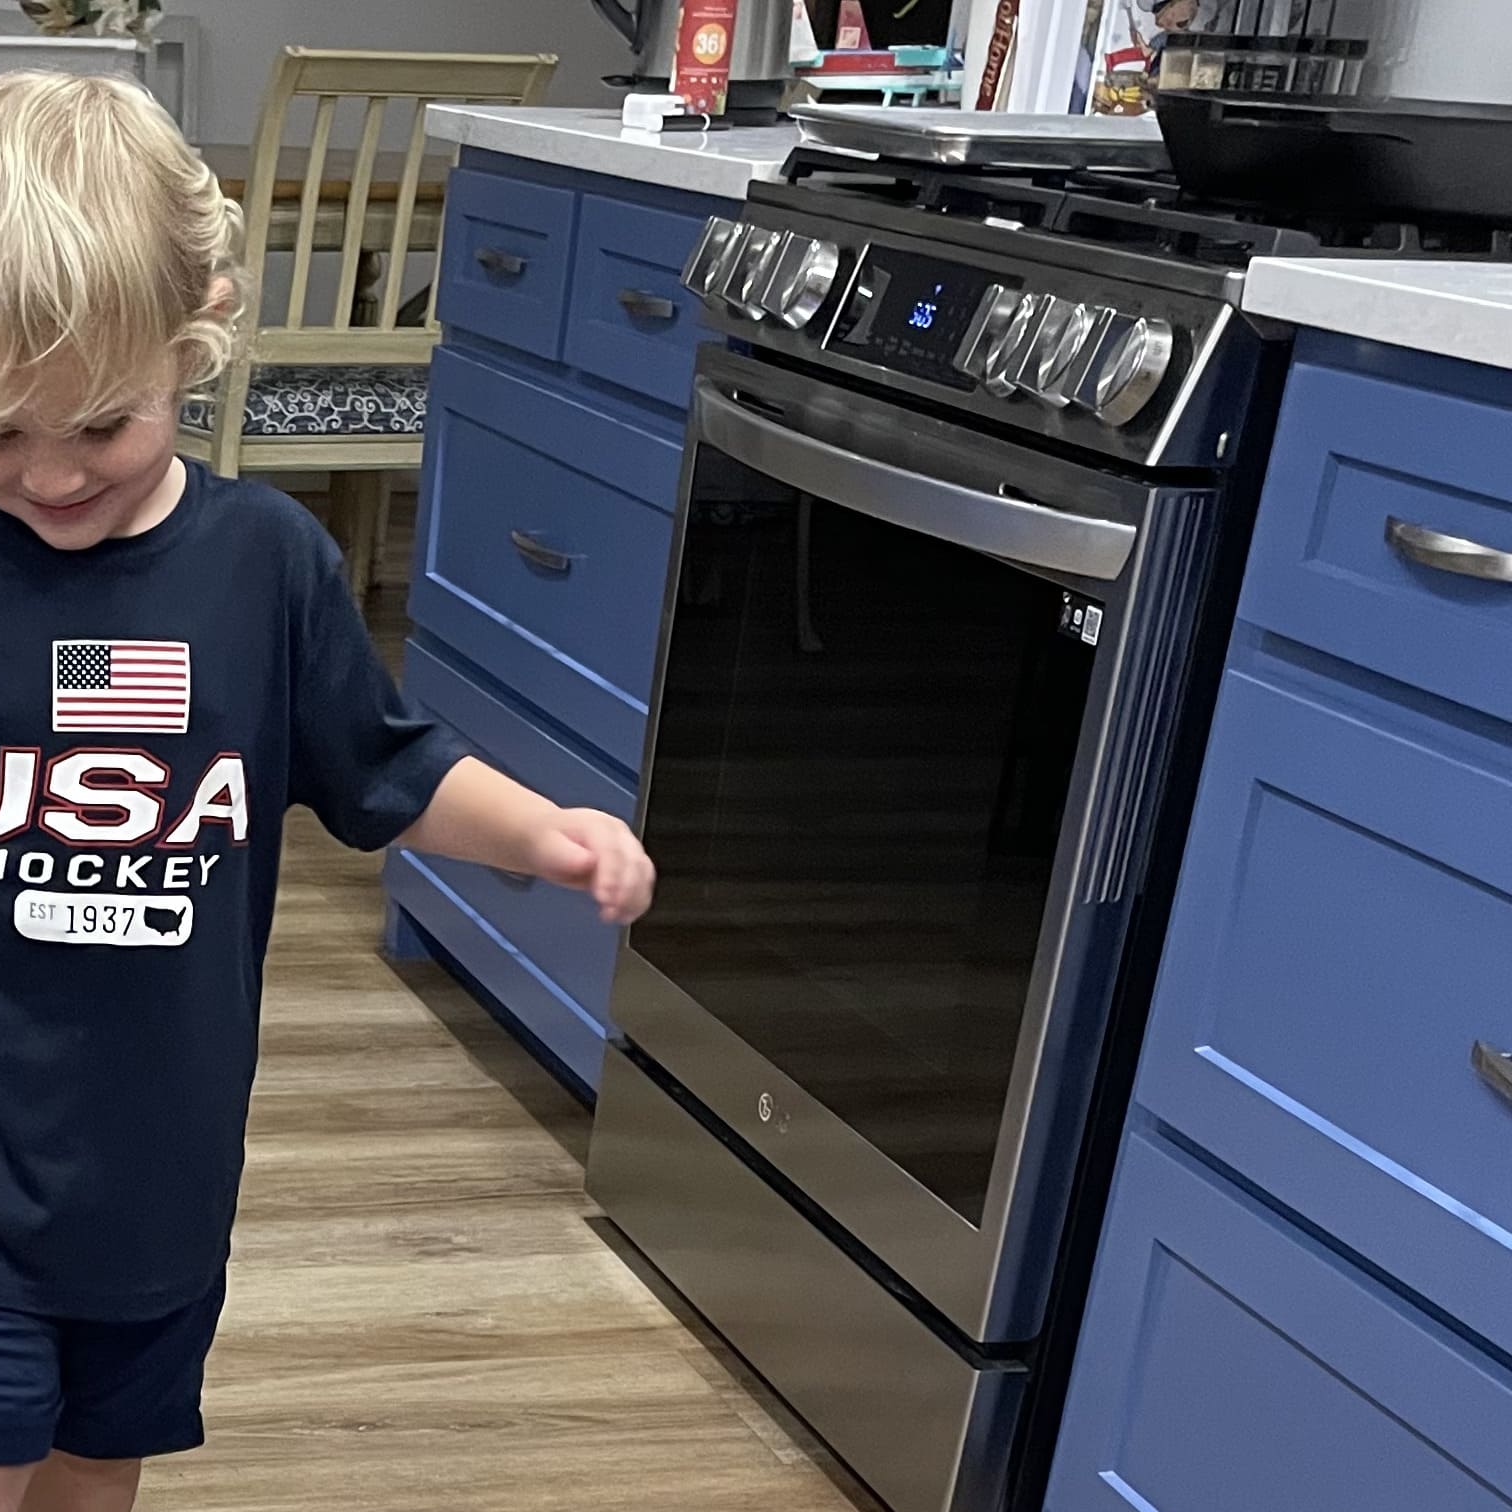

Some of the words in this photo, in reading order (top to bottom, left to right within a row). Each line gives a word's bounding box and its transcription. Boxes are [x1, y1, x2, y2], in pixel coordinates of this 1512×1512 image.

[696, 33, 719, 54] 36
[29, 902, 57, 921] EST
[65, 904, 136, 937] 1937
